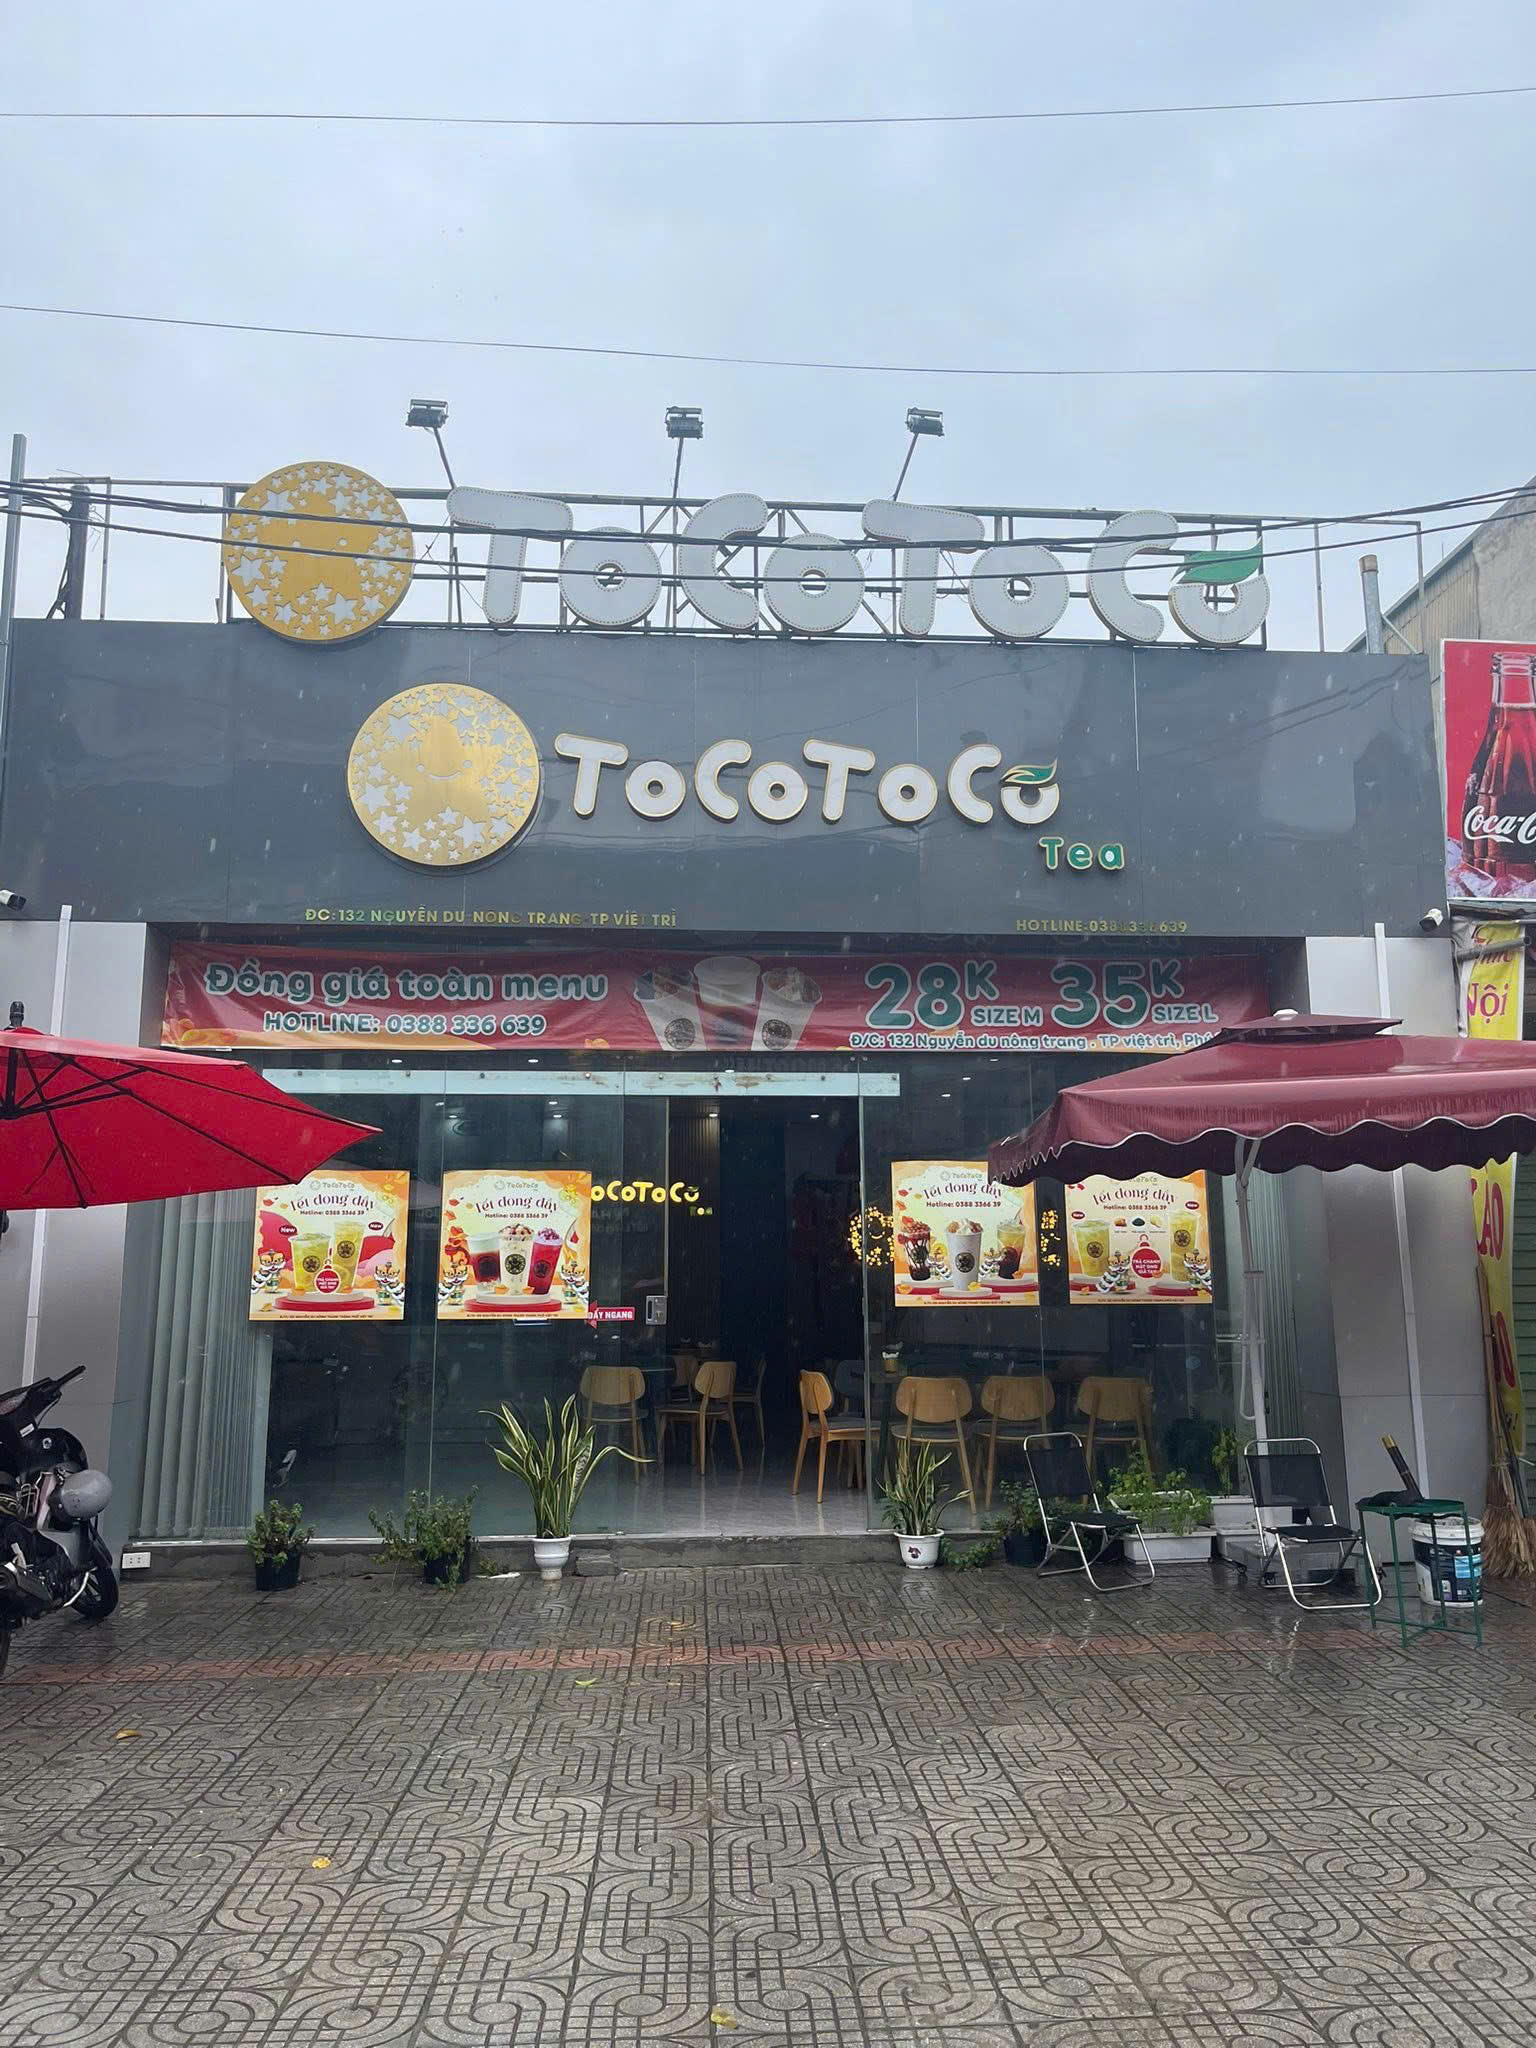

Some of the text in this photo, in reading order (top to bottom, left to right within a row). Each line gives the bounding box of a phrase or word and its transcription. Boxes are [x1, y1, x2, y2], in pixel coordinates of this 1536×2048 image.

[447, 485, 1270, 645] ToCoToCo
[554, 733, 1060, 825] ToCoToCo
[1464, 805, 1536, 844] Coca-C
[1038, 836, 1125, 871] Tea
[591, 913, 609, 925] TP
[205, 957, 609, 1007] Đồng giá toàn menu
[263, 1012, 547, 1036] HOTLINE: 0388 336 639
[971, 1006, 1021, 1026] SIZE
[1022, 1006, 1043, 1027] M
[1152, 1004, 1200, 1023] SIZE
[1202, 1003, 1219, 1023] L
[850, 1034, 885, 1047] Đ/C:
[888, 1034, 914, 1047] 132
[916, 1031, 974, 1050] Nguyễn
[1000, 1033, 1039, 1050] nông
[1043, 1036, 1087, 1050] trang
[1099, 1035, 1121, 1048] TP
[1124, 1033, 1154, 1050] việt
[591, 1180, 700, 1203] oCoToCo
[605, 1311, 633, 1319] NGANG
